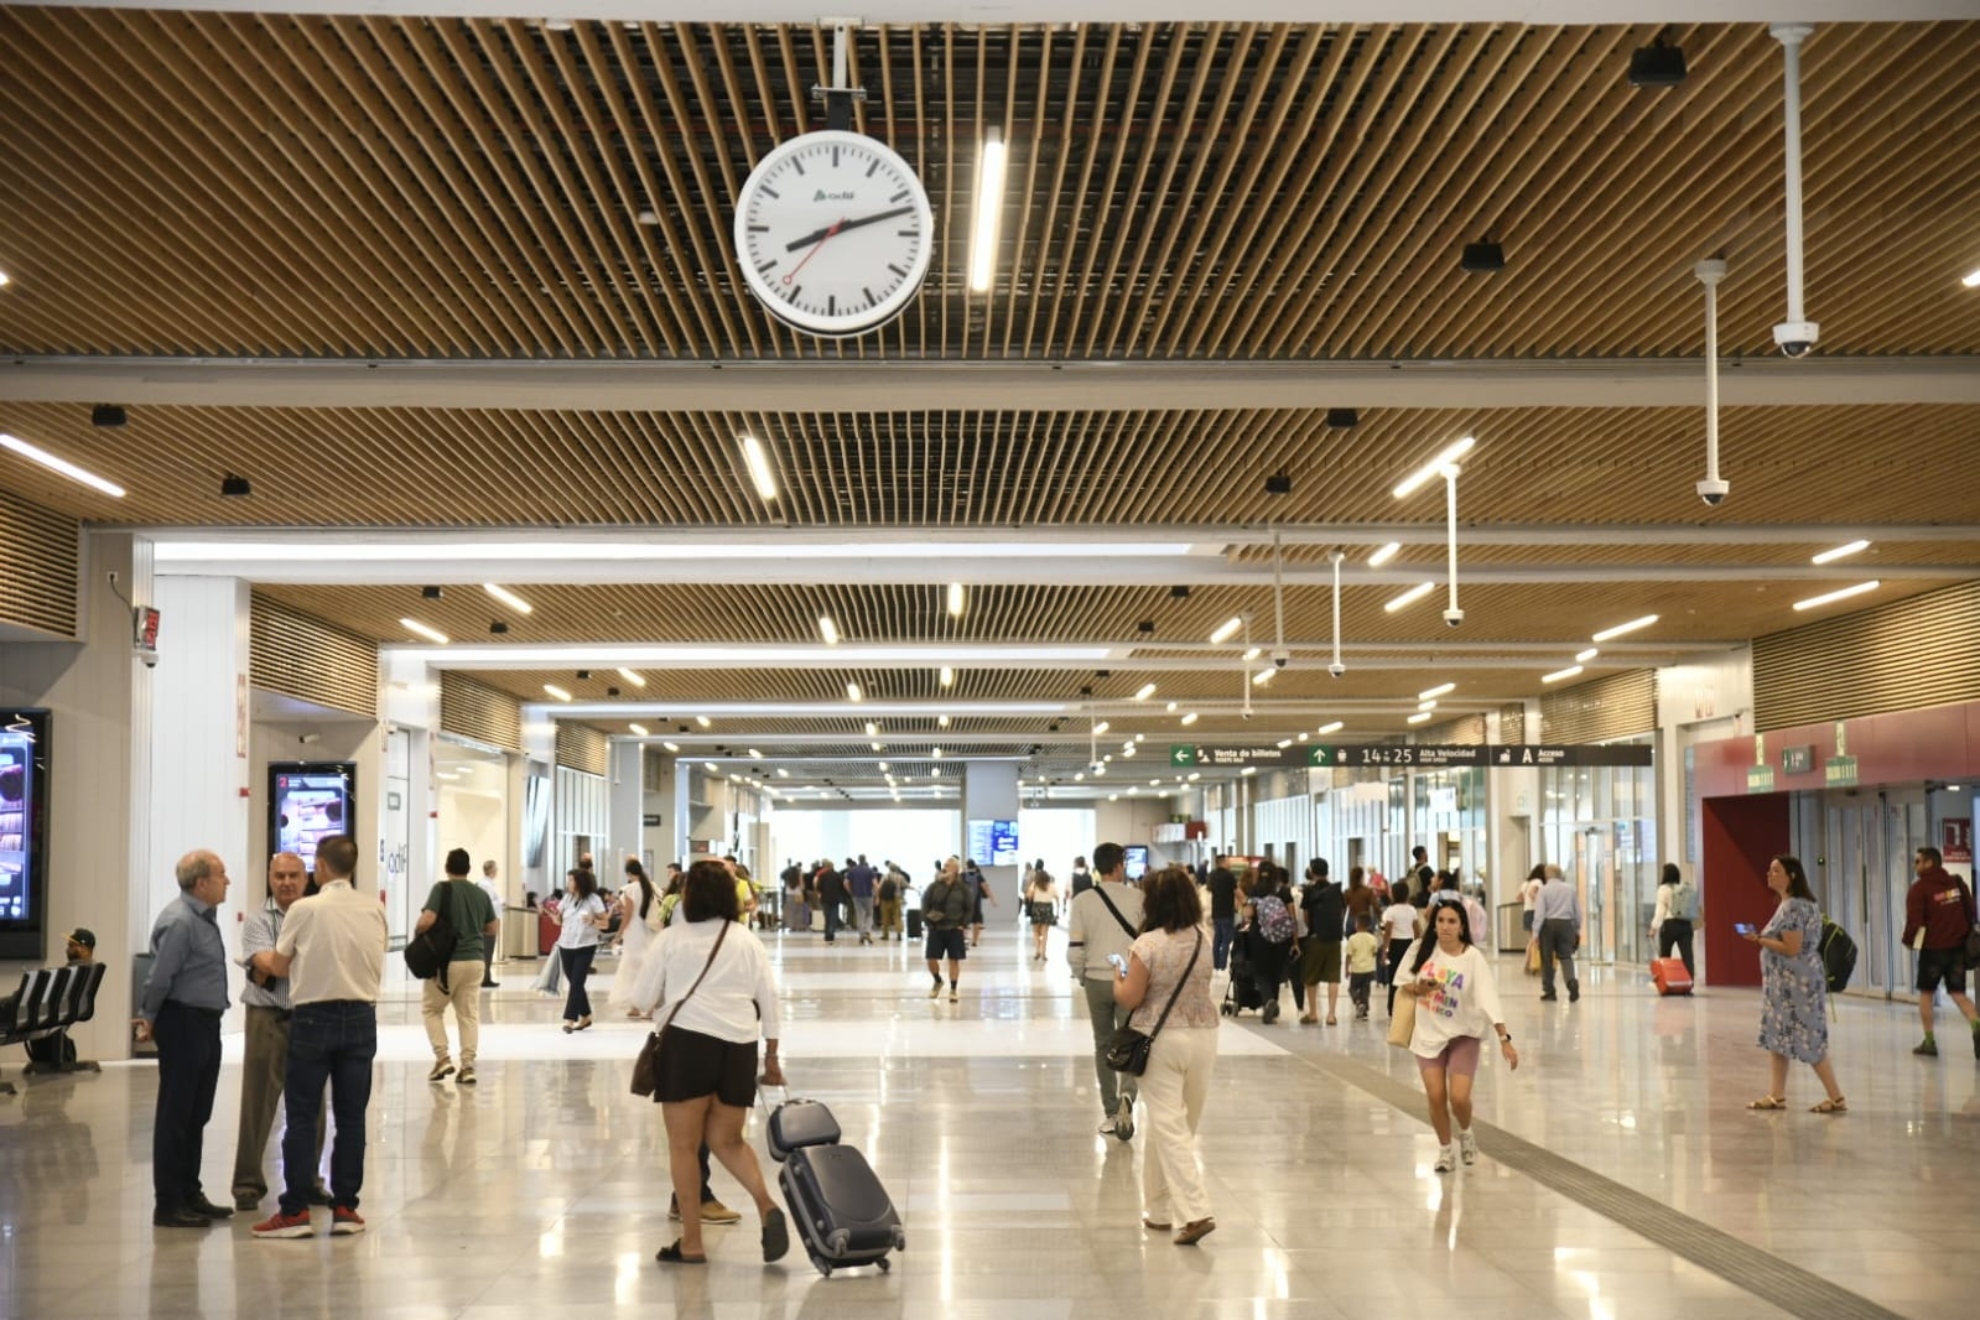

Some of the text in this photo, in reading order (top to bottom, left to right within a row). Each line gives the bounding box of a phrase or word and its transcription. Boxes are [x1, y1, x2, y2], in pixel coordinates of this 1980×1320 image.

[1362, 748, 1381, 763] 14
[1393, 748, 1412, 763] 25
[1419, 749, 1476, 758] Alta Velocidad
[1522, 747, 1533, 763] A
